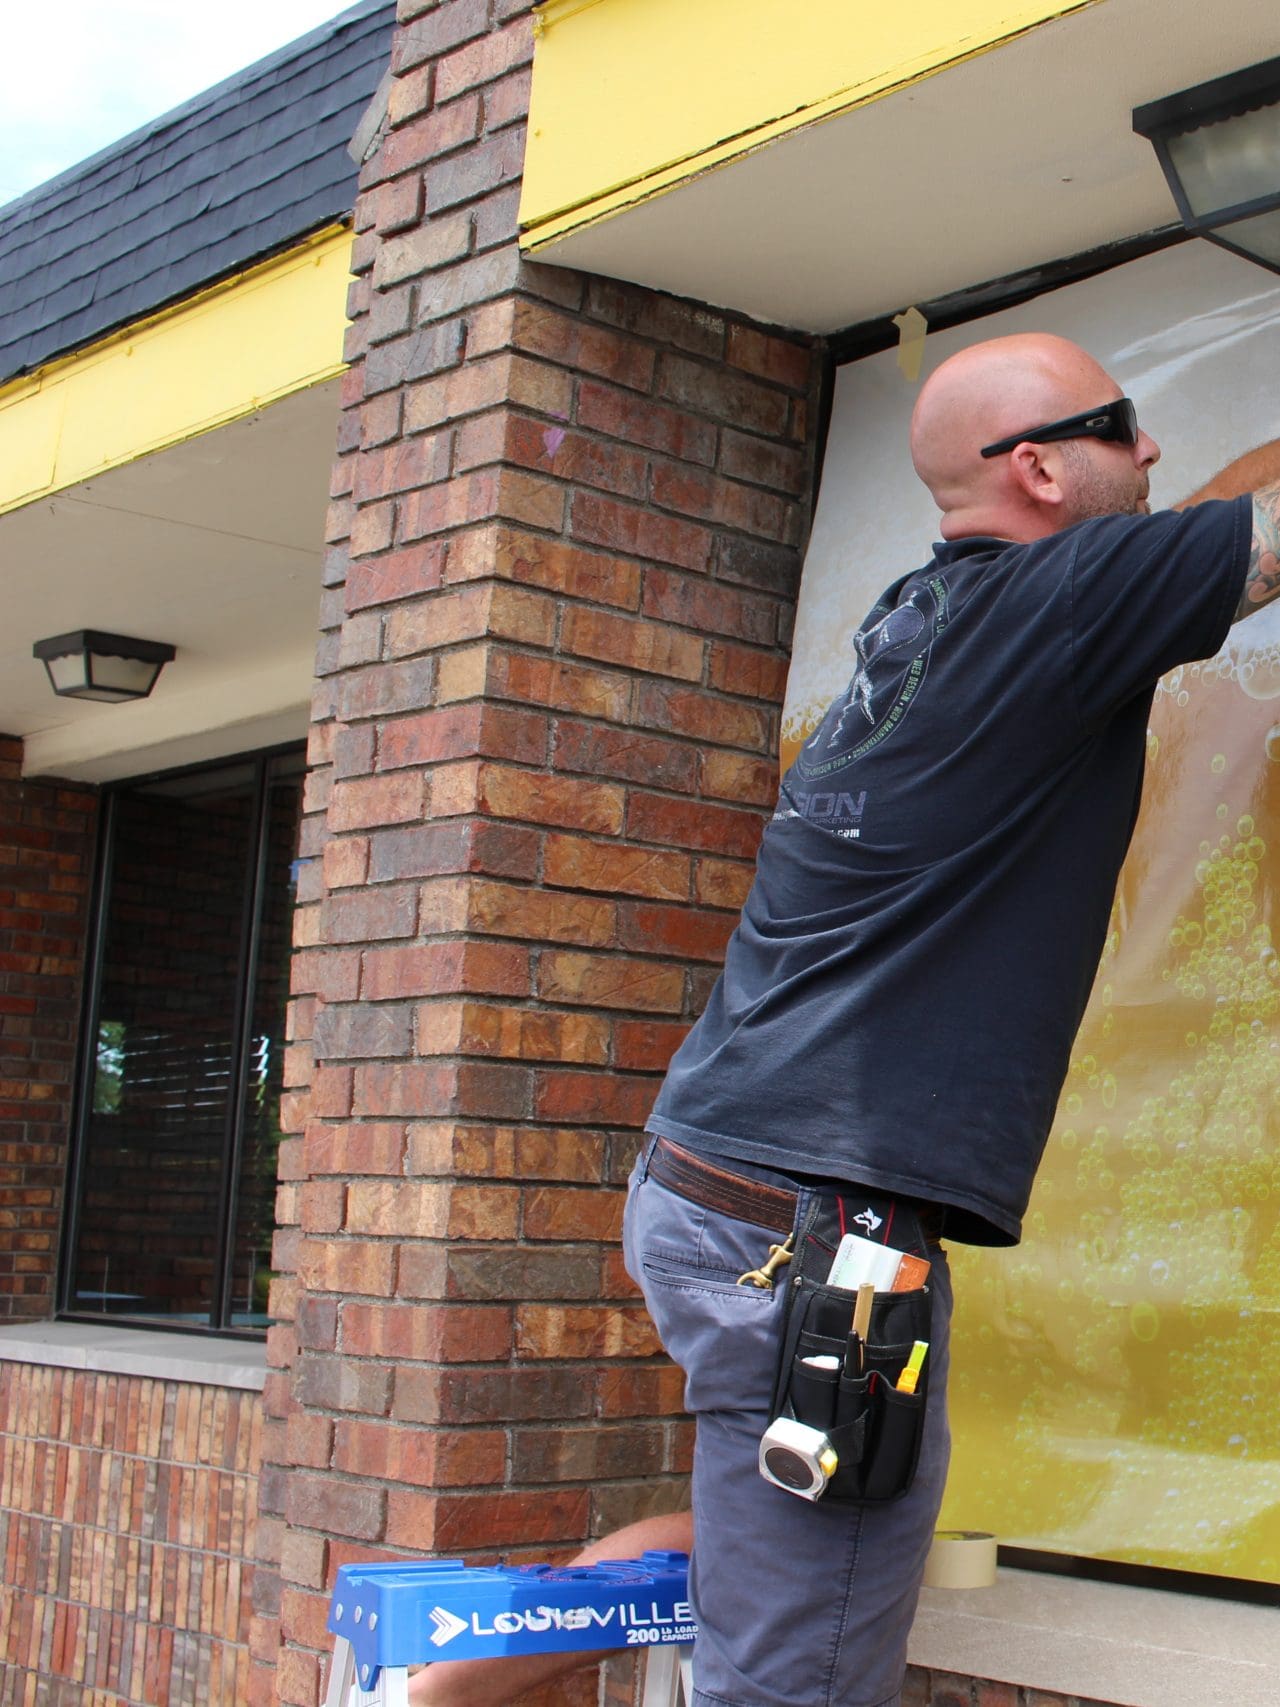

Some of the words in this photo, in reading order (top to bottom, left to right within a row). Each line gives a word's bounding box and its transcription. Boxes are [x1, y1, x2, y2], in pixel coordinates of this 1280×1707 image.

[900, 675, 919, 702] DESIGN
[626, 1627, 660, 1644] 200
[674, 1625, 700, 1634] LOAD
[661, 1633, 699, 1642] CAPACITY
